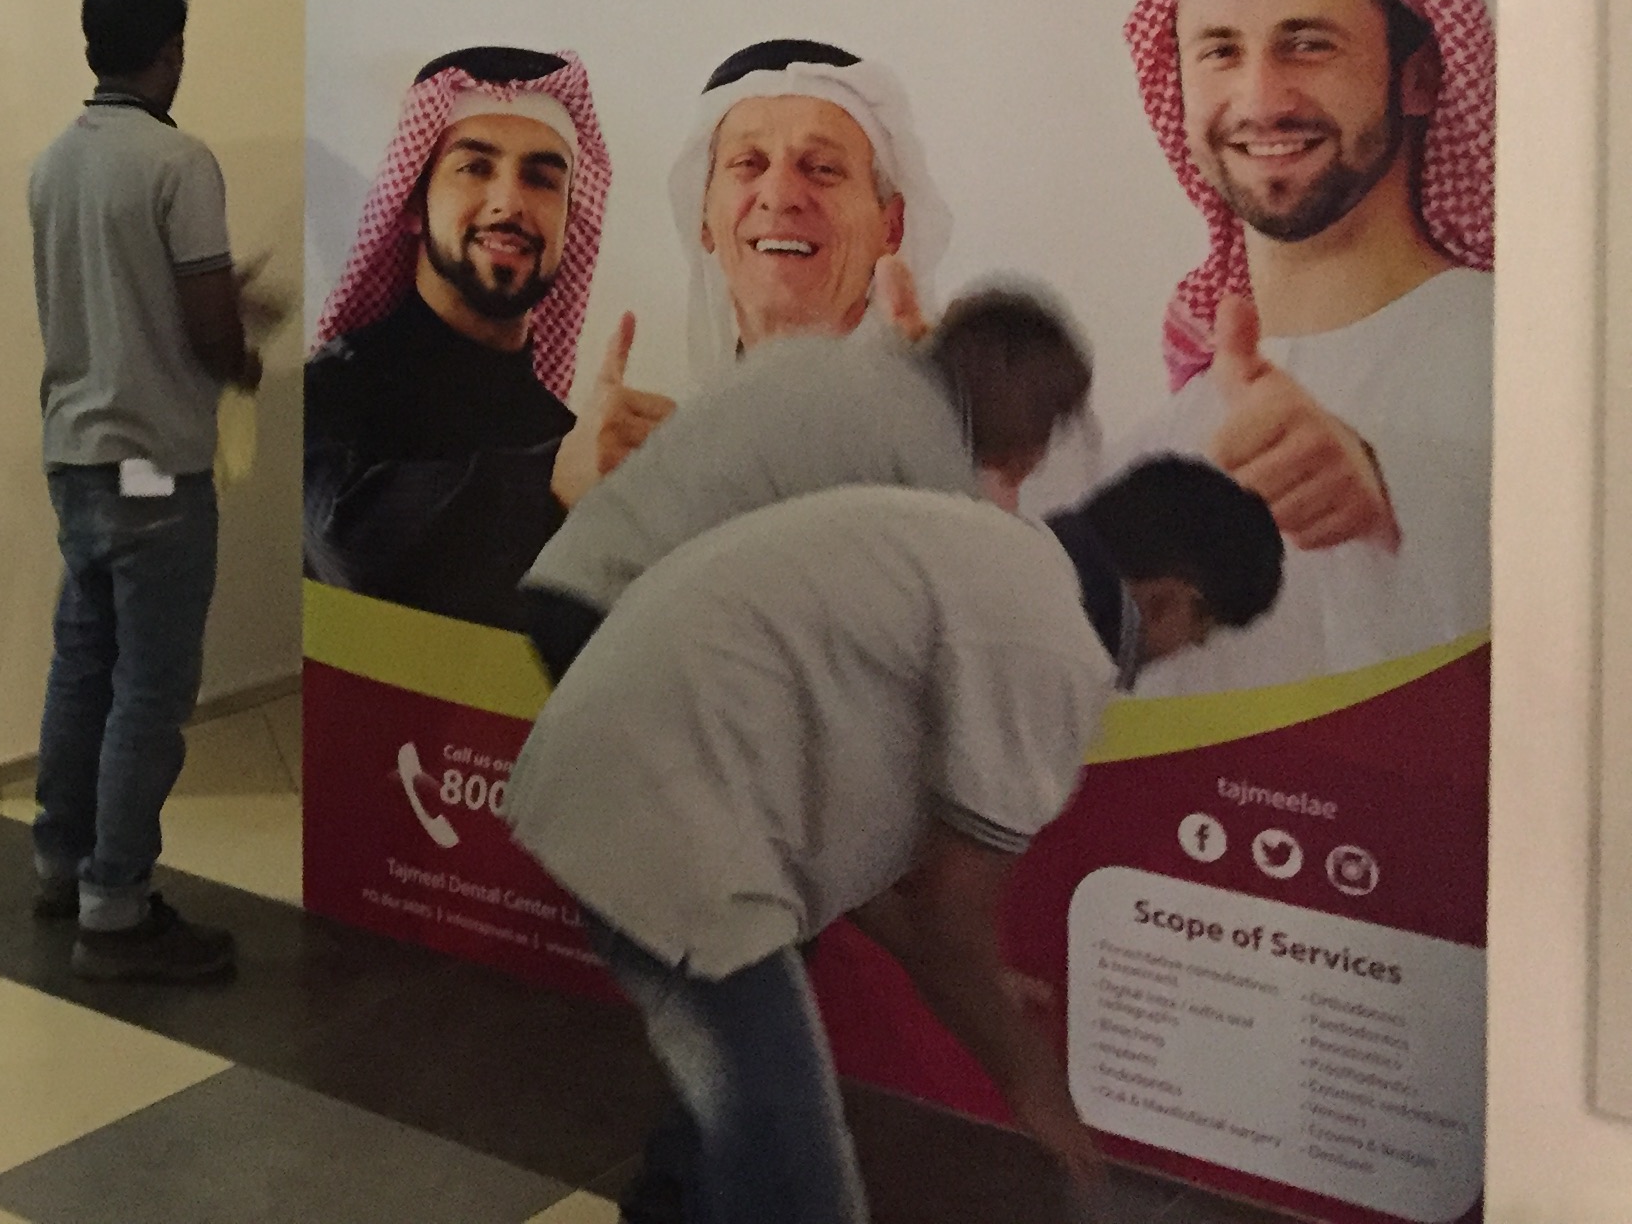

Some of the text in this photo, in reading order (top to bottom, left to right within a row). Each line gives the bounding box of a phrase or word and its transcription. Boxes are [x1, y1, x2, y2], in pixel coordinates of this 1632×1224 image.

[442, 744, 472, 765] Call
[473, 753, 490, 769] us
[439, 768, 509, 818] 800
[1216, 776, 1340, 821] tajmeelae
[386, 857, 447, 889] Tajmeel
[449, 875, 501, 905] Dental
[503, 889, 558, 920] Center
[1133, 898, 1404, 987] Scope of Services
